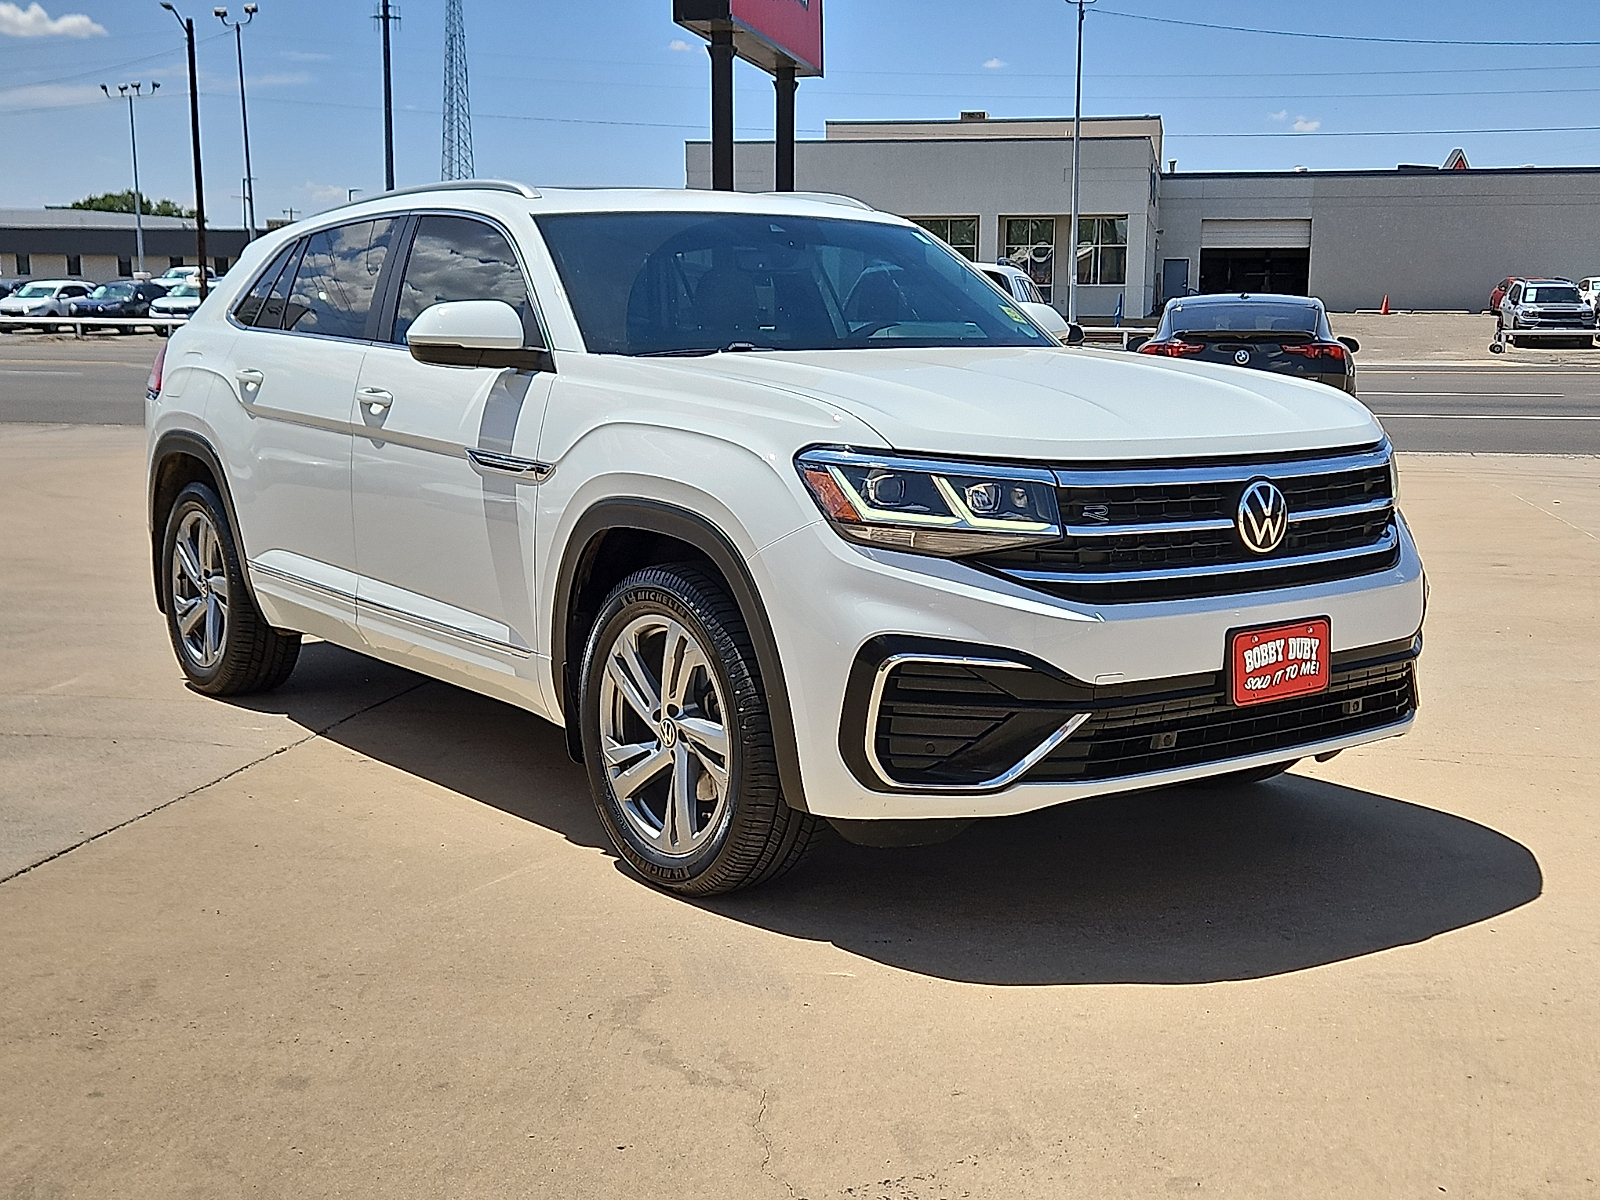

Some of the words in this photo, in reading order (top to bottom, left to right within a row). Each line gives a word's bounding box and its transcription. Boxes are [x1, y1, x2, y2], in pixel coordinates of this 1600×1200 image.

[637, 590, 688, 620] MICHELIN
[1243, 638, 1285, 674] BOBBY
[1287, 637, 1320, 661] DUBY
[1244, 674, 1272, 690] SOLD
[1272, 669, 1285, 686] IT
[1285, 663, 1299, 681] TO
[1299, 660, 1320, 676] ME!
